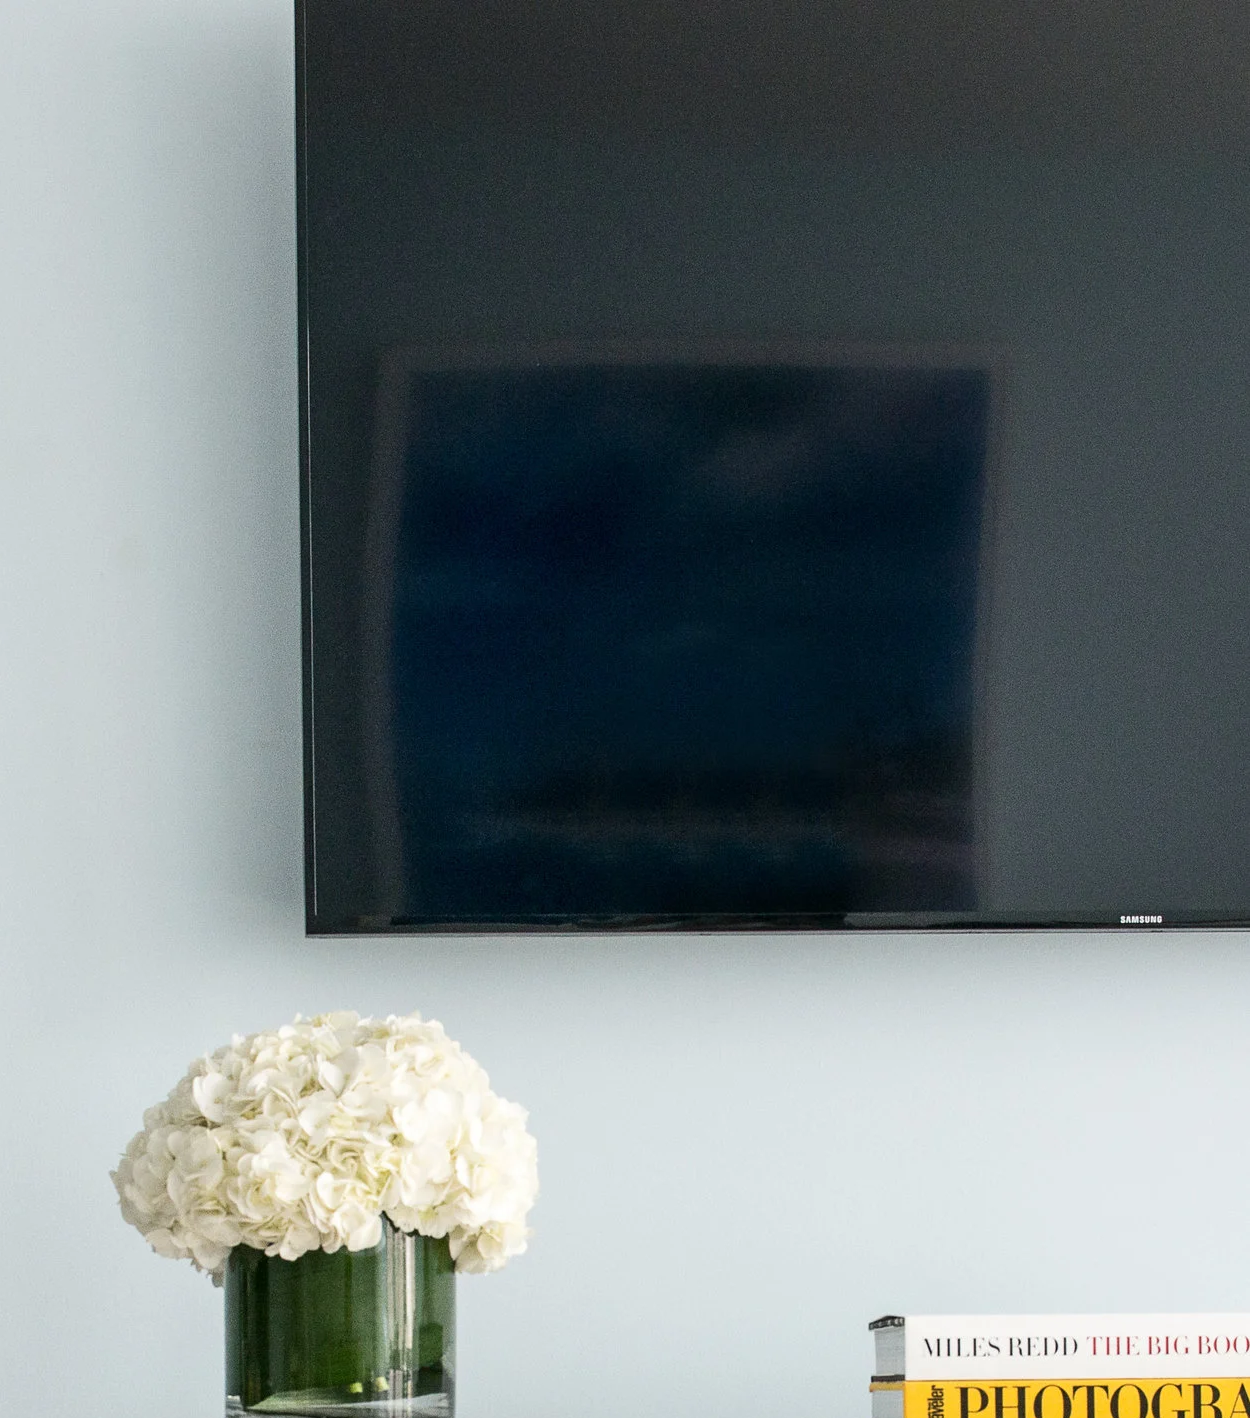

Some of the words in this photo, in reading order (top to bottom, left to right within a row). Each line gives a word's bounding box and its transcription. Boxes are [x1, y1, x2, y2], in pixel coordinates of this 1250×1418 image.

[1120, 915, 1163, 924] SAMSUNG
[923, 1337, 1001, 1358] MILES
[1009, 1336, 1079, 1357] REDD
[1086, 1335, 1140, 1357] THE
[1147, 1335, 1191, 1356] BIG
[1197, 1334, 1250, 1355] BOO
